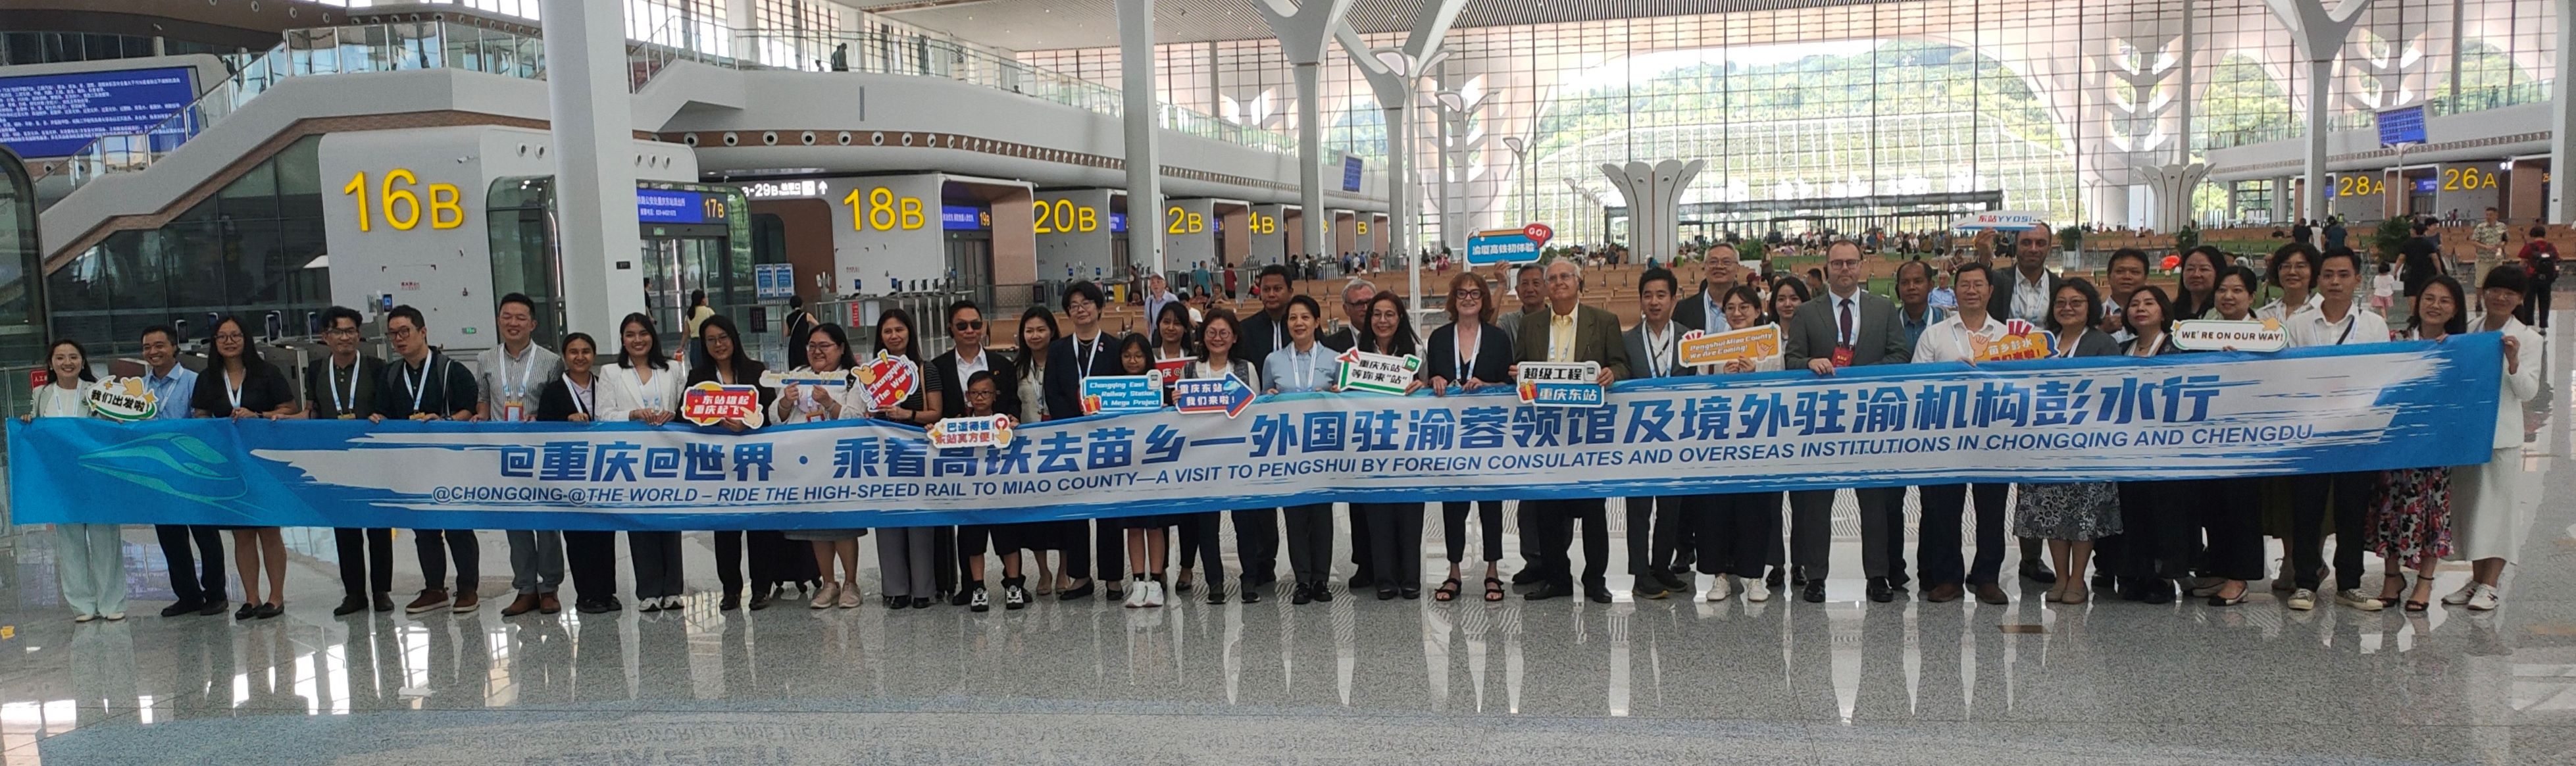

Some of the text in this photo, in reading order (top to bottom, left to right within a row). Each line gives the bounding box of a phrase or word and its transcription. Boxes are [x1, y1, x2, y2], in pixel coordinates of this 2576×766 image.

[2340, 176, 2385, 196] 28A
[2444, 168, 2497, 191] 26A
[344, 168, 465, 232] 16B
[705, 198, 724, 218] 17B
[843, 187, 925, 232] 18B
[1034, 199, 1098, 234] 20B
[1528, 227, 1546, 238] GO!
[2258, 332, 2283, 341] WAY!
[1690, 340, 1726, 351] Pengshui
[1359, 359, 1401, 372] 重庆东站
[1524, 367, 1582, 380] 超级工程
[1180, 383, 1222, 394] 重庆东站
[1539, 388, 1597, 401] 重庆东站
[702, 395, 750, 405] 东站雄起
[693, 405, 740, 415] 重庆起飞
[630, 488, 697, 501] WORLD
[717, 488, 761, 501] RIDE
[766, 487, 799, 501] THE
[804, 482, 920, 501] HIGH-SPEED
[925, 482, 967, 497] RAIL
[973, 481, 997, 496] TO
[1002, 479, 1051, 495] MIAO
[1176, 466, 1223, 484] VISIT
[1228, 465, 1253, 479] TO
[1259, 458, 1355, 477] PENGSHUI
[1361, 457, 1387, 472] BY
[1392, 455, 1482, 472] FOREIGN
[1488, 449, 1624, 470] CONSULATES
[1628, 448, 1673, 465] AND
[1679, 443, 1795, 463] OVERSEAS
[1801, 436, 1950, 458] INSTITUTIONS
[1957, 434, 1980, 450] IN
[1986, 430, 2128, 451] CHONGQING
[2134, 429, 2185, 446] AND
[2192, 424, 2313, 444] CHENGDU
